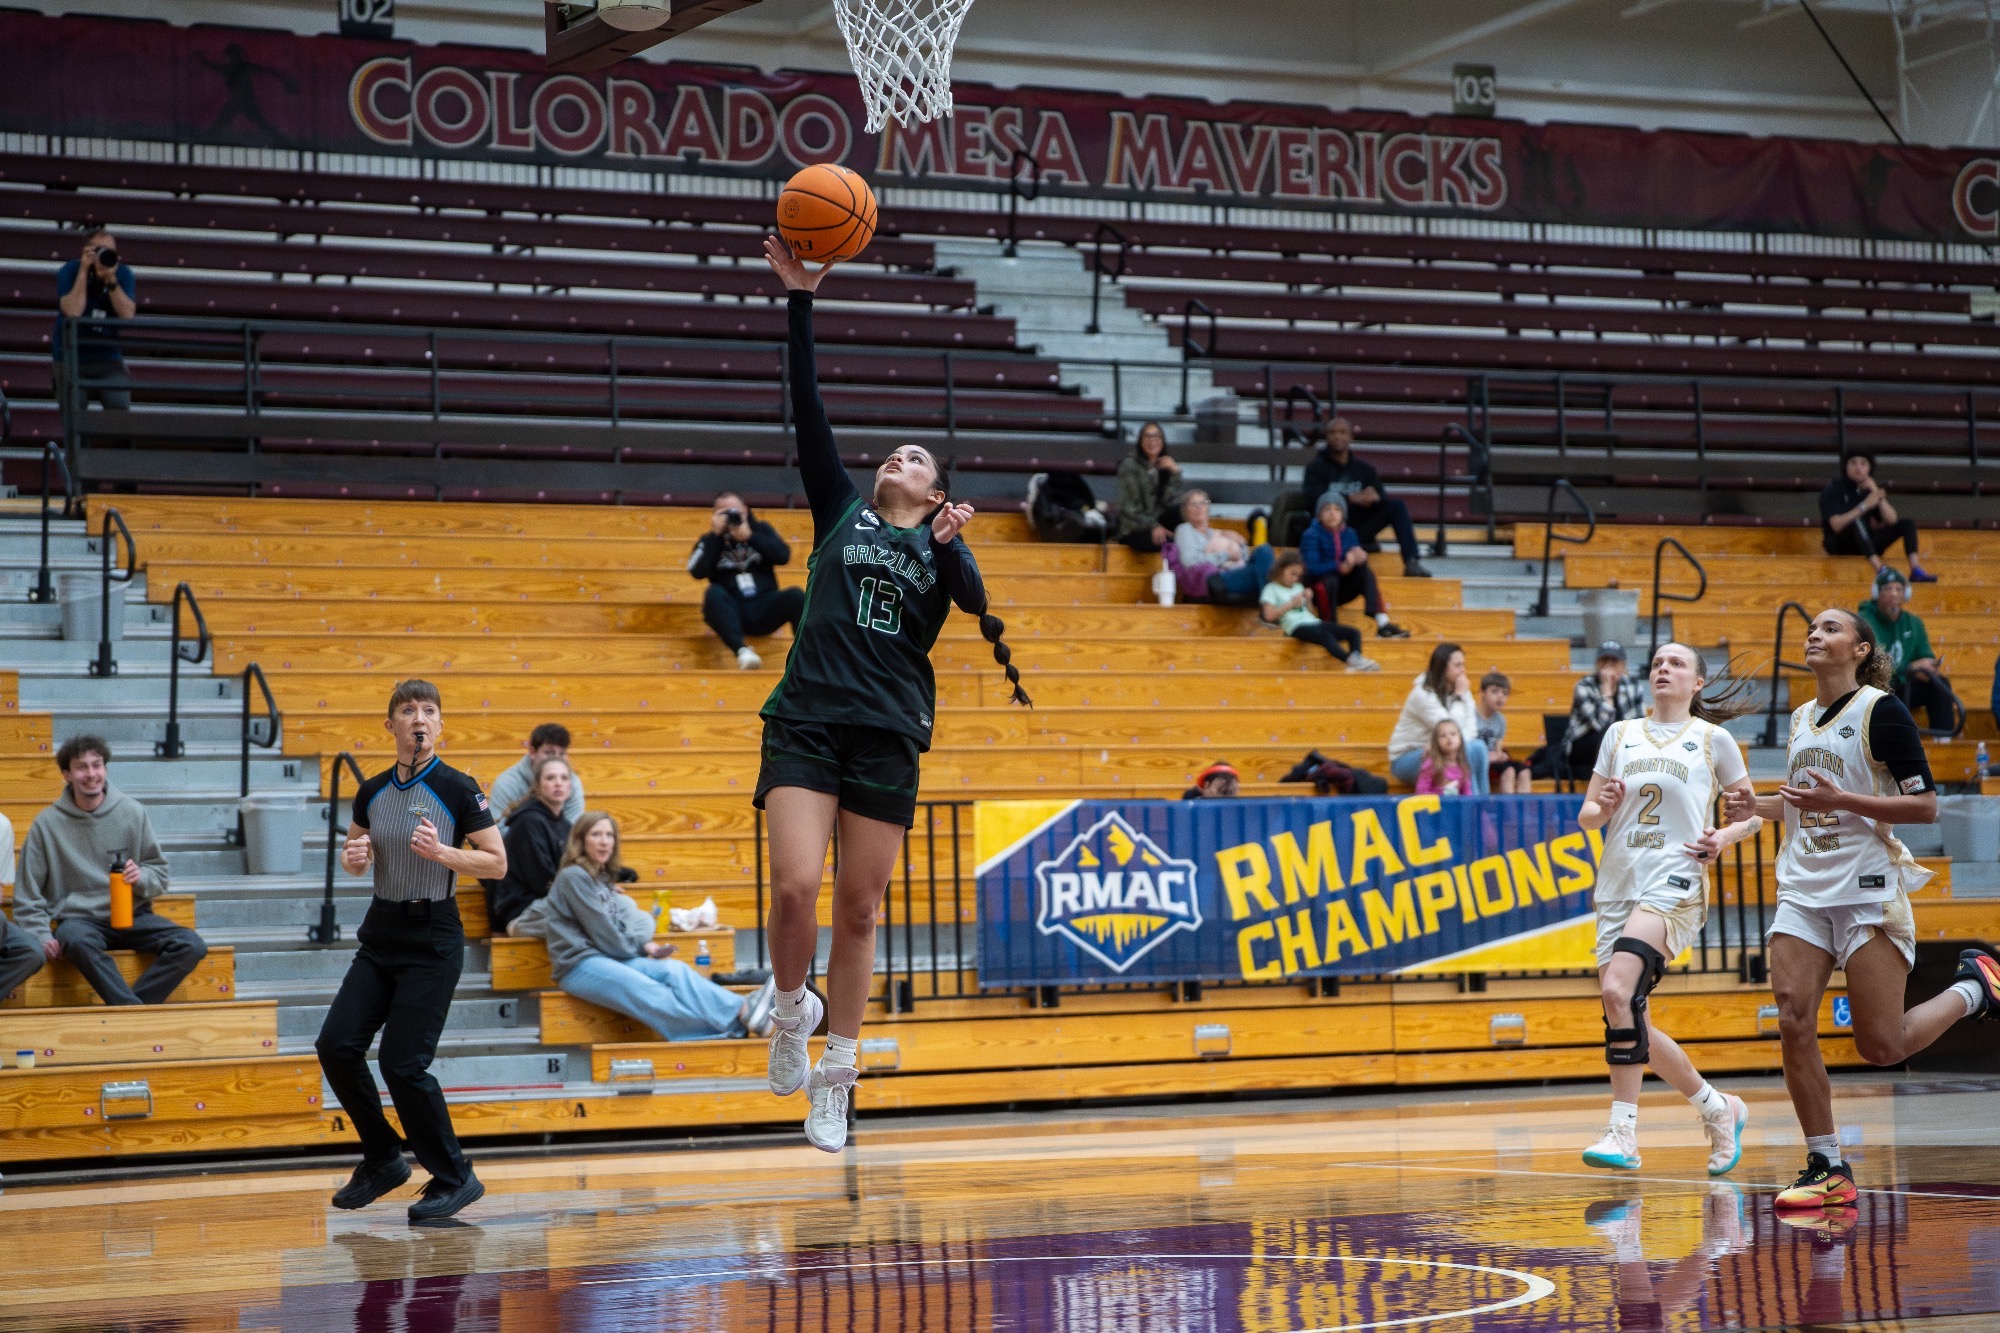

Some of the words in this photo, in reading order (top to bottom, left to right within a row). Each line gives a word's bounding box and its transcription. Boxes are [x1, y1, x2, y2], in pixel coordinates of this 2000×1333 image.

[341, 0, 395, 24] 102
[1452, 75, 1496, 105] 103
[349, 56, 853, 168] COLORADO
[876, 104, 1087, 188] MESA
[1107, 110, 1507, 211] MAVERICKS
[843, 544, 936, 594] GRIZZLIES
[856, 576, 905, 635] 13
[1622, 757, 1689, 783] MOUNTAIN
[1789, 747, 1844, 779] MOUNTAIN
[1638, 783, 1663, 825] 2
[1627, 830, 1666, 849] LIONS
[1802, 832, 1841, 855] LIONS
[1214, 793, 1454, 922] RMAC
[1051, 869, 1191, 918] RMAC
[498, 1003, 512, 1018] C
[547, 1058, 561, 1074] B
[331, 1115, 345, 1132] A
[574, 1102, 587, 1118] A
